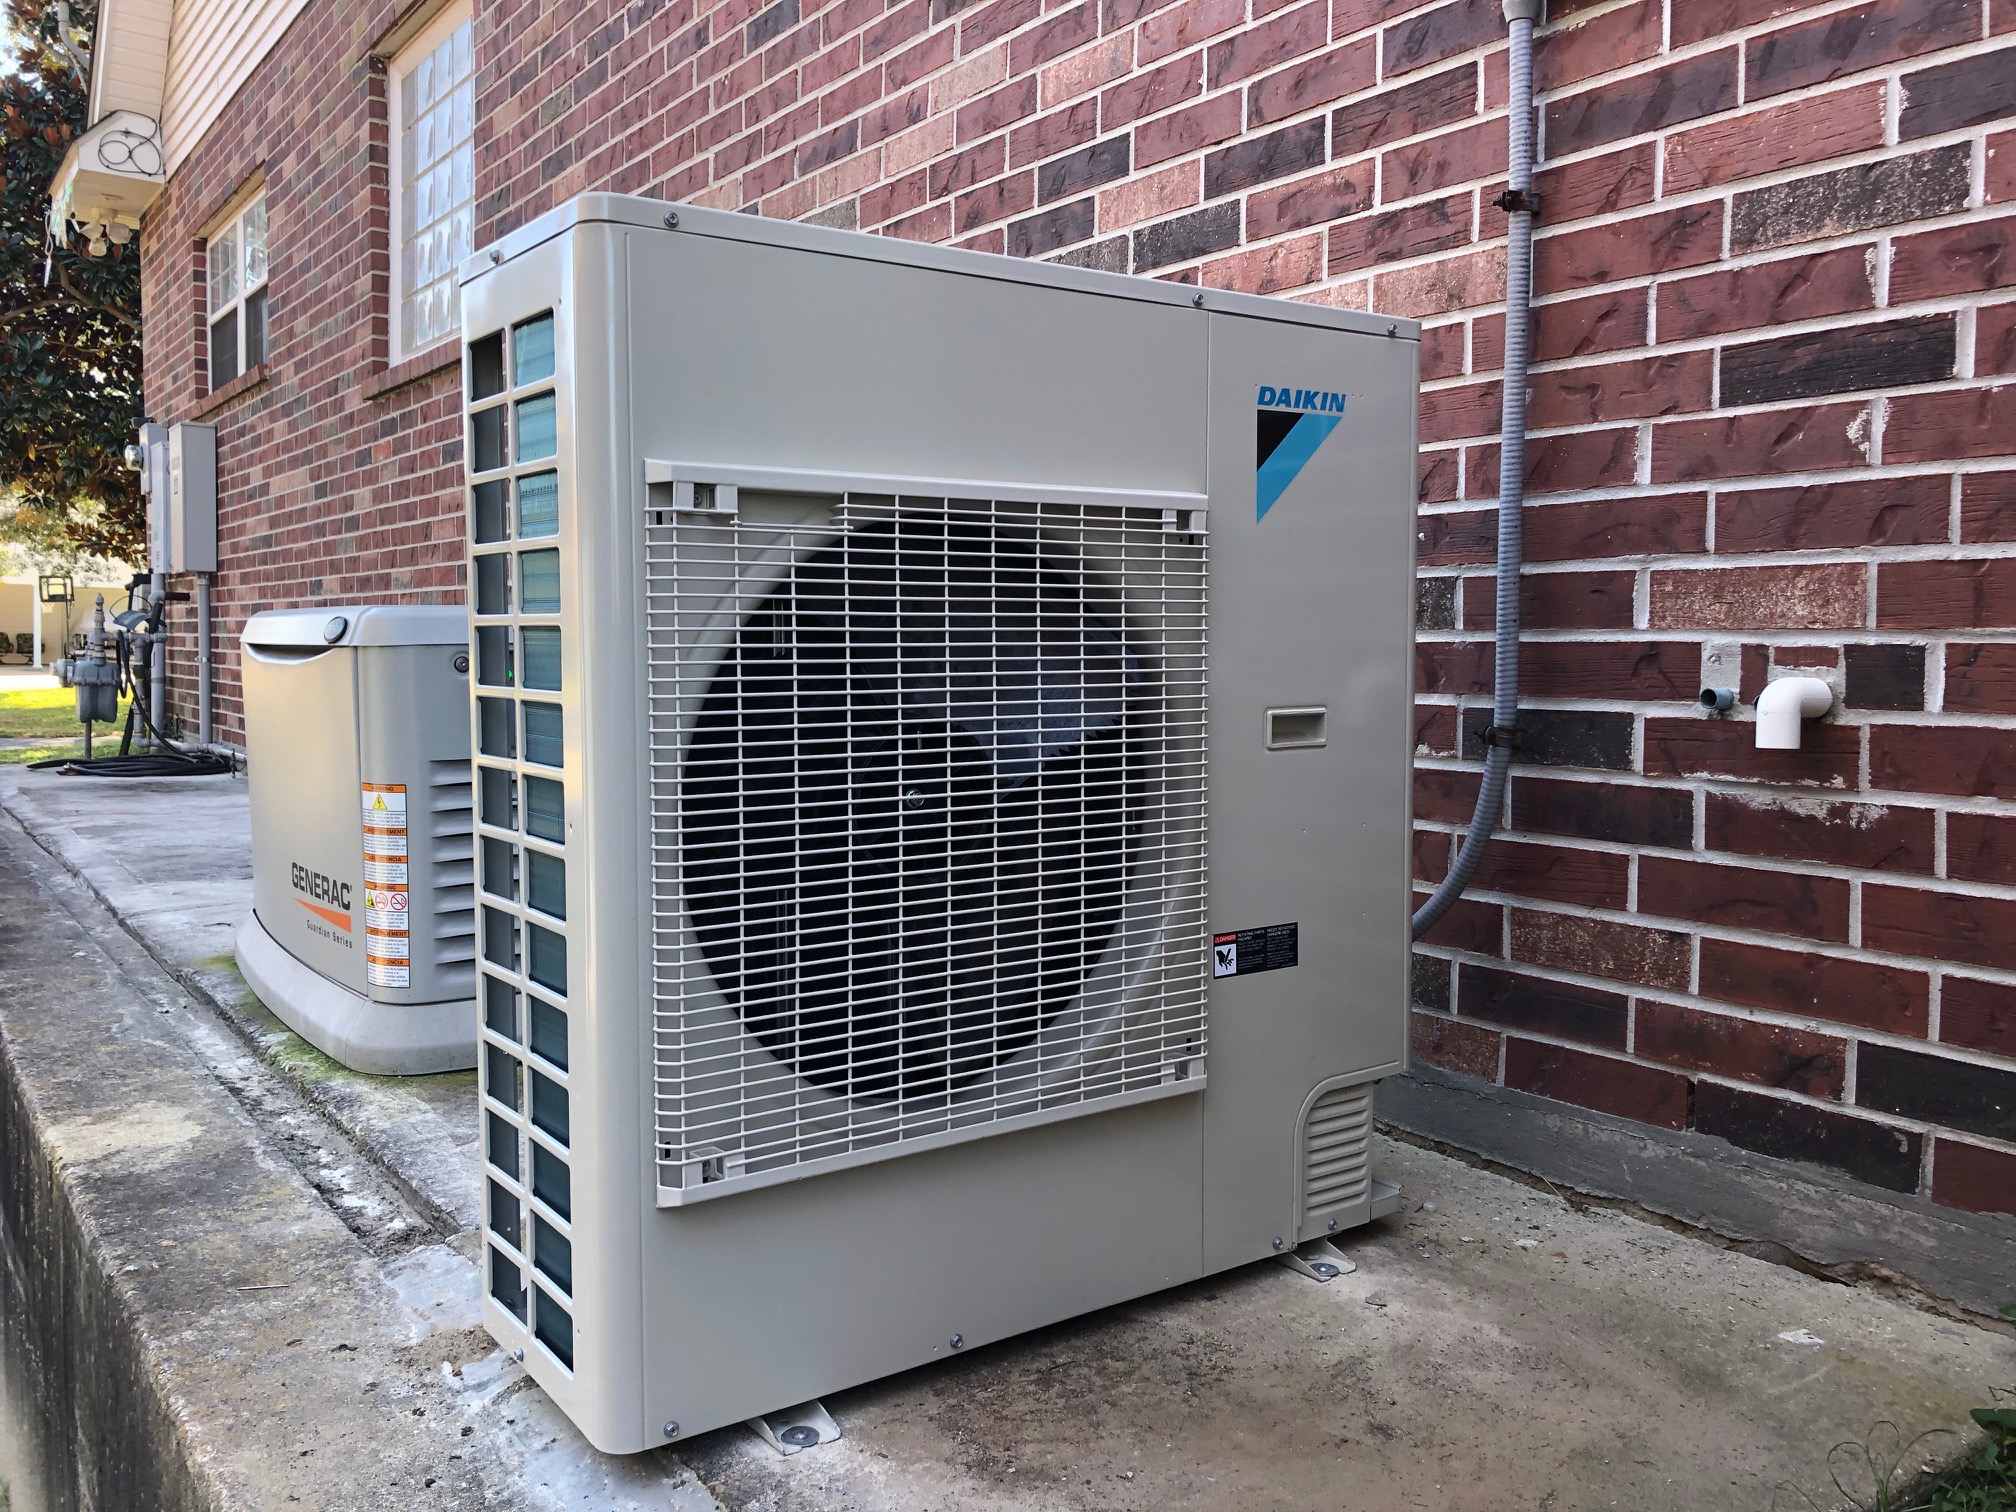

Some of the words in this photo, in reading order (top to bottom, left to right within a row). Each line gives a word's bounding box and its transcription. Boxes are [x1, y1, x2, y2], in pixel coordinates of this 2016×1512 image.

[1257, 386, 1346, 413] DAIKIN
[291, 862, 351, 911] GENERAC
[306, 919, 330, 939] Guardian
[332, 932, 353, 949] Series
[1220, 934, 1236, 943] DANGER
